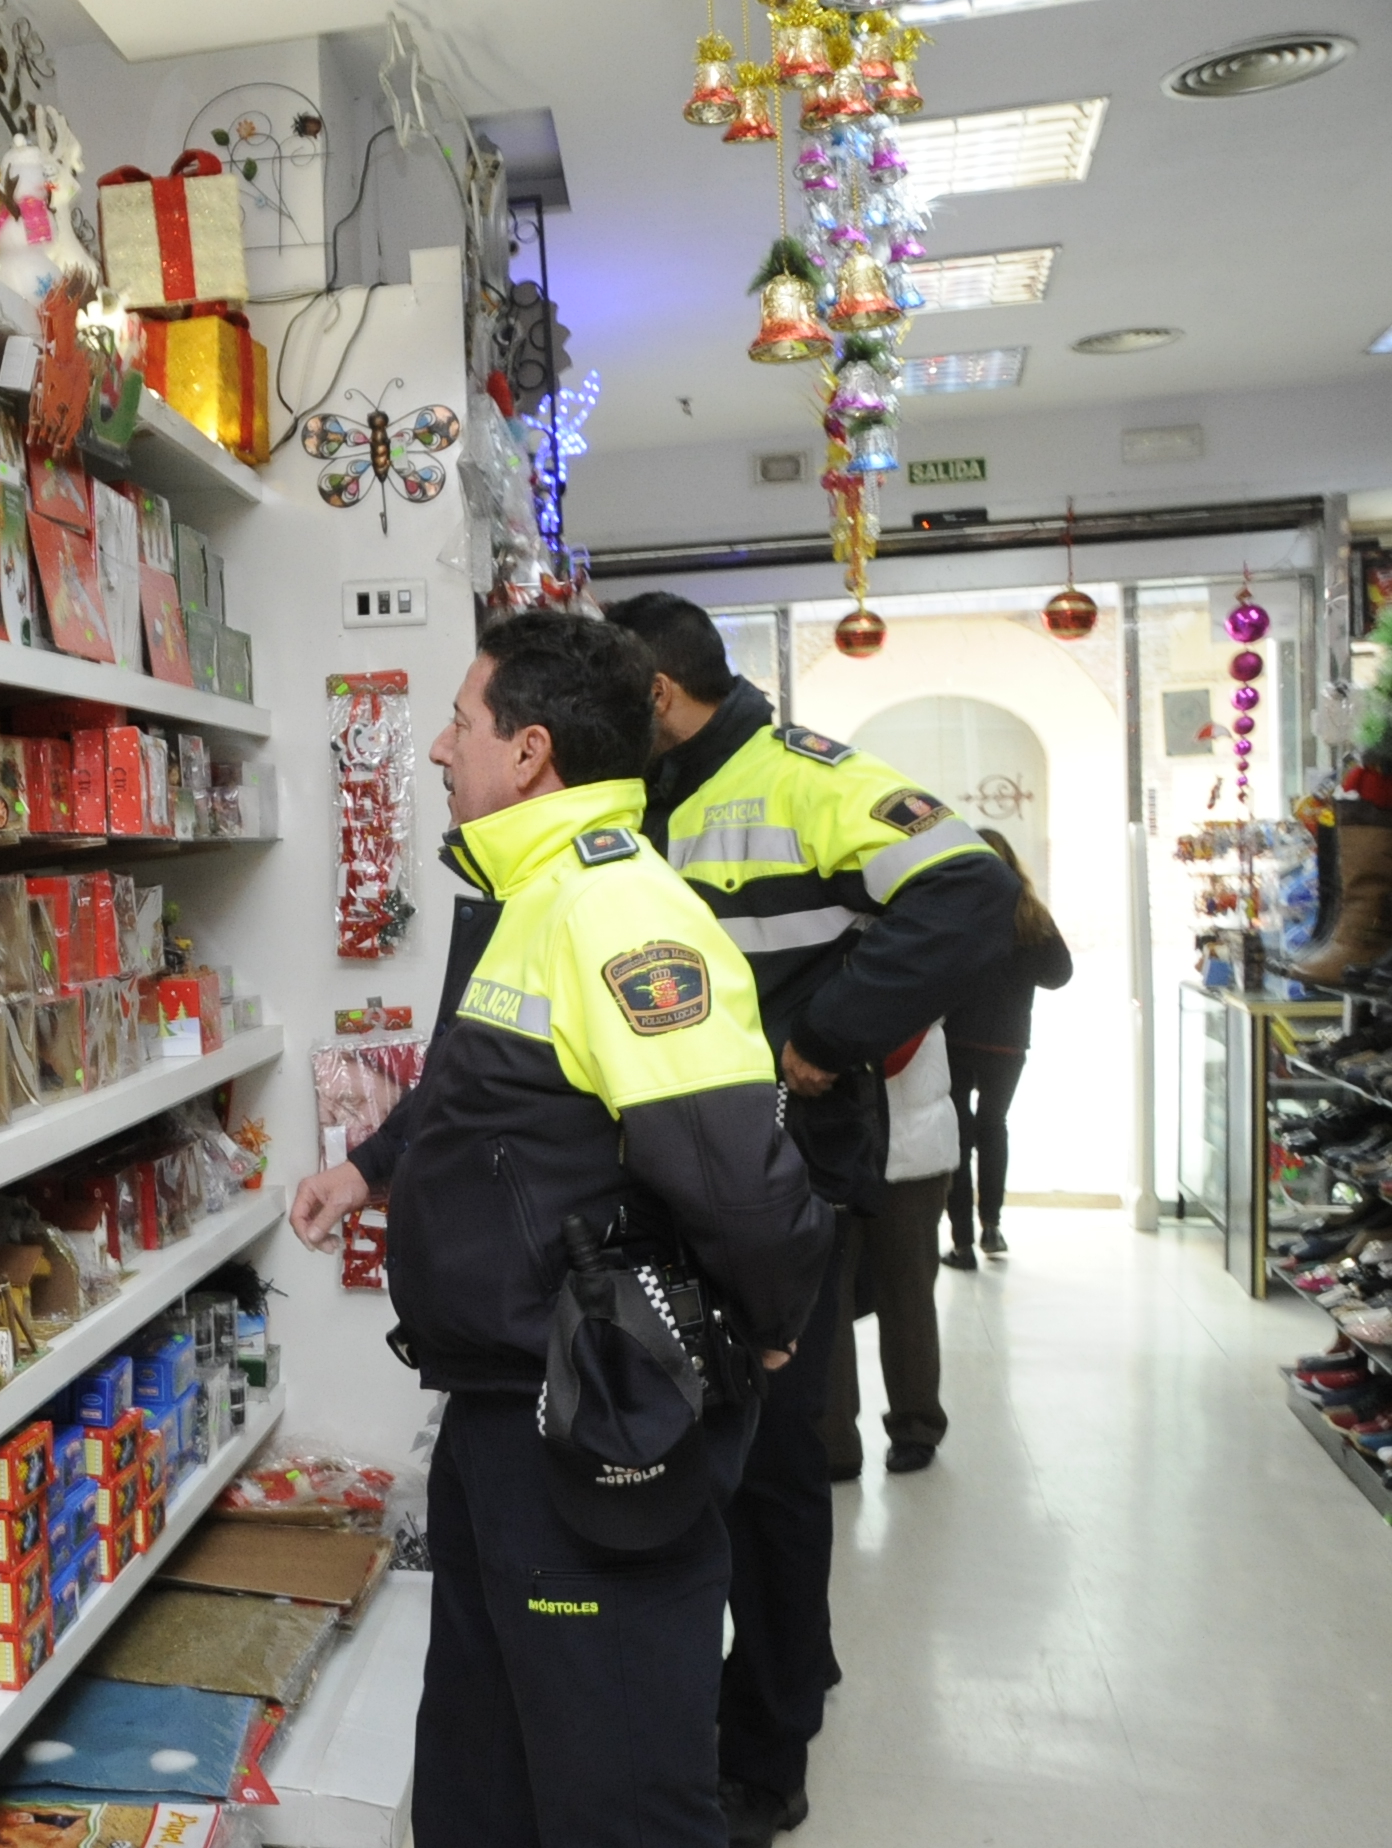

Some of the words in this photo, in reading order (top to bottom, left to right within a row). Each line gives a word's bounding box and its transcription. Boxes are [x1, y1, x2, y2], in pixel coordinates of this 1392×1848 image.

[911, 460, 982, 484] SALIDA
[706, 803, 761, 822] POLICIA
[464, 981, 522, 1022] POLICIA
[641, 1010, 674, 1026] POLICIA
[674, 1005, 700, 1020] LOCAL
[528, 1598, 599, 1614] MÓSTOLES
